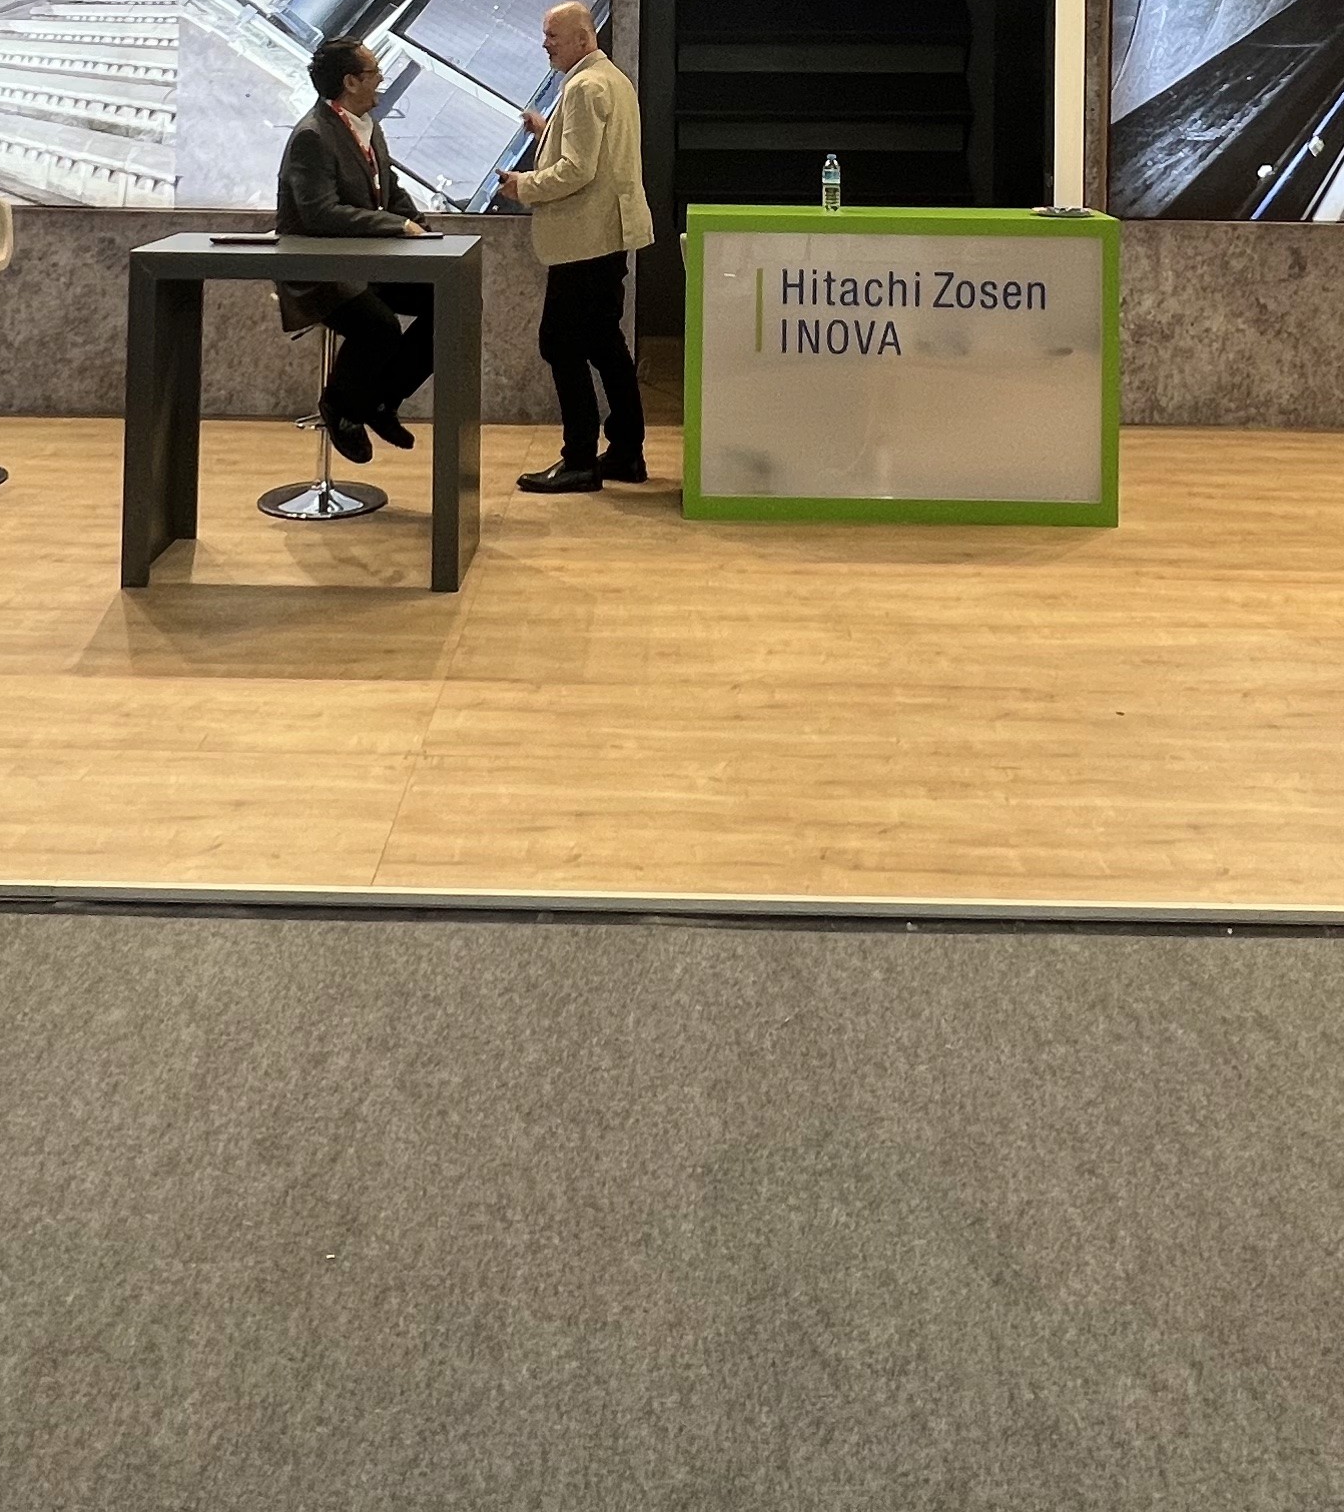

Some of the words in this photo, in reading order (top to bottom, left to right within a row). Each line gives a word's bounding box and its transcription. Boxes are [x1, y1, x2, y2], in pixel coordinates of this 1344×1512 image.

[781, 268, 921, 308] Hitachi
[933, 272, 1047, 310] Zosen
[780, 318, 902, 356] INOVA
